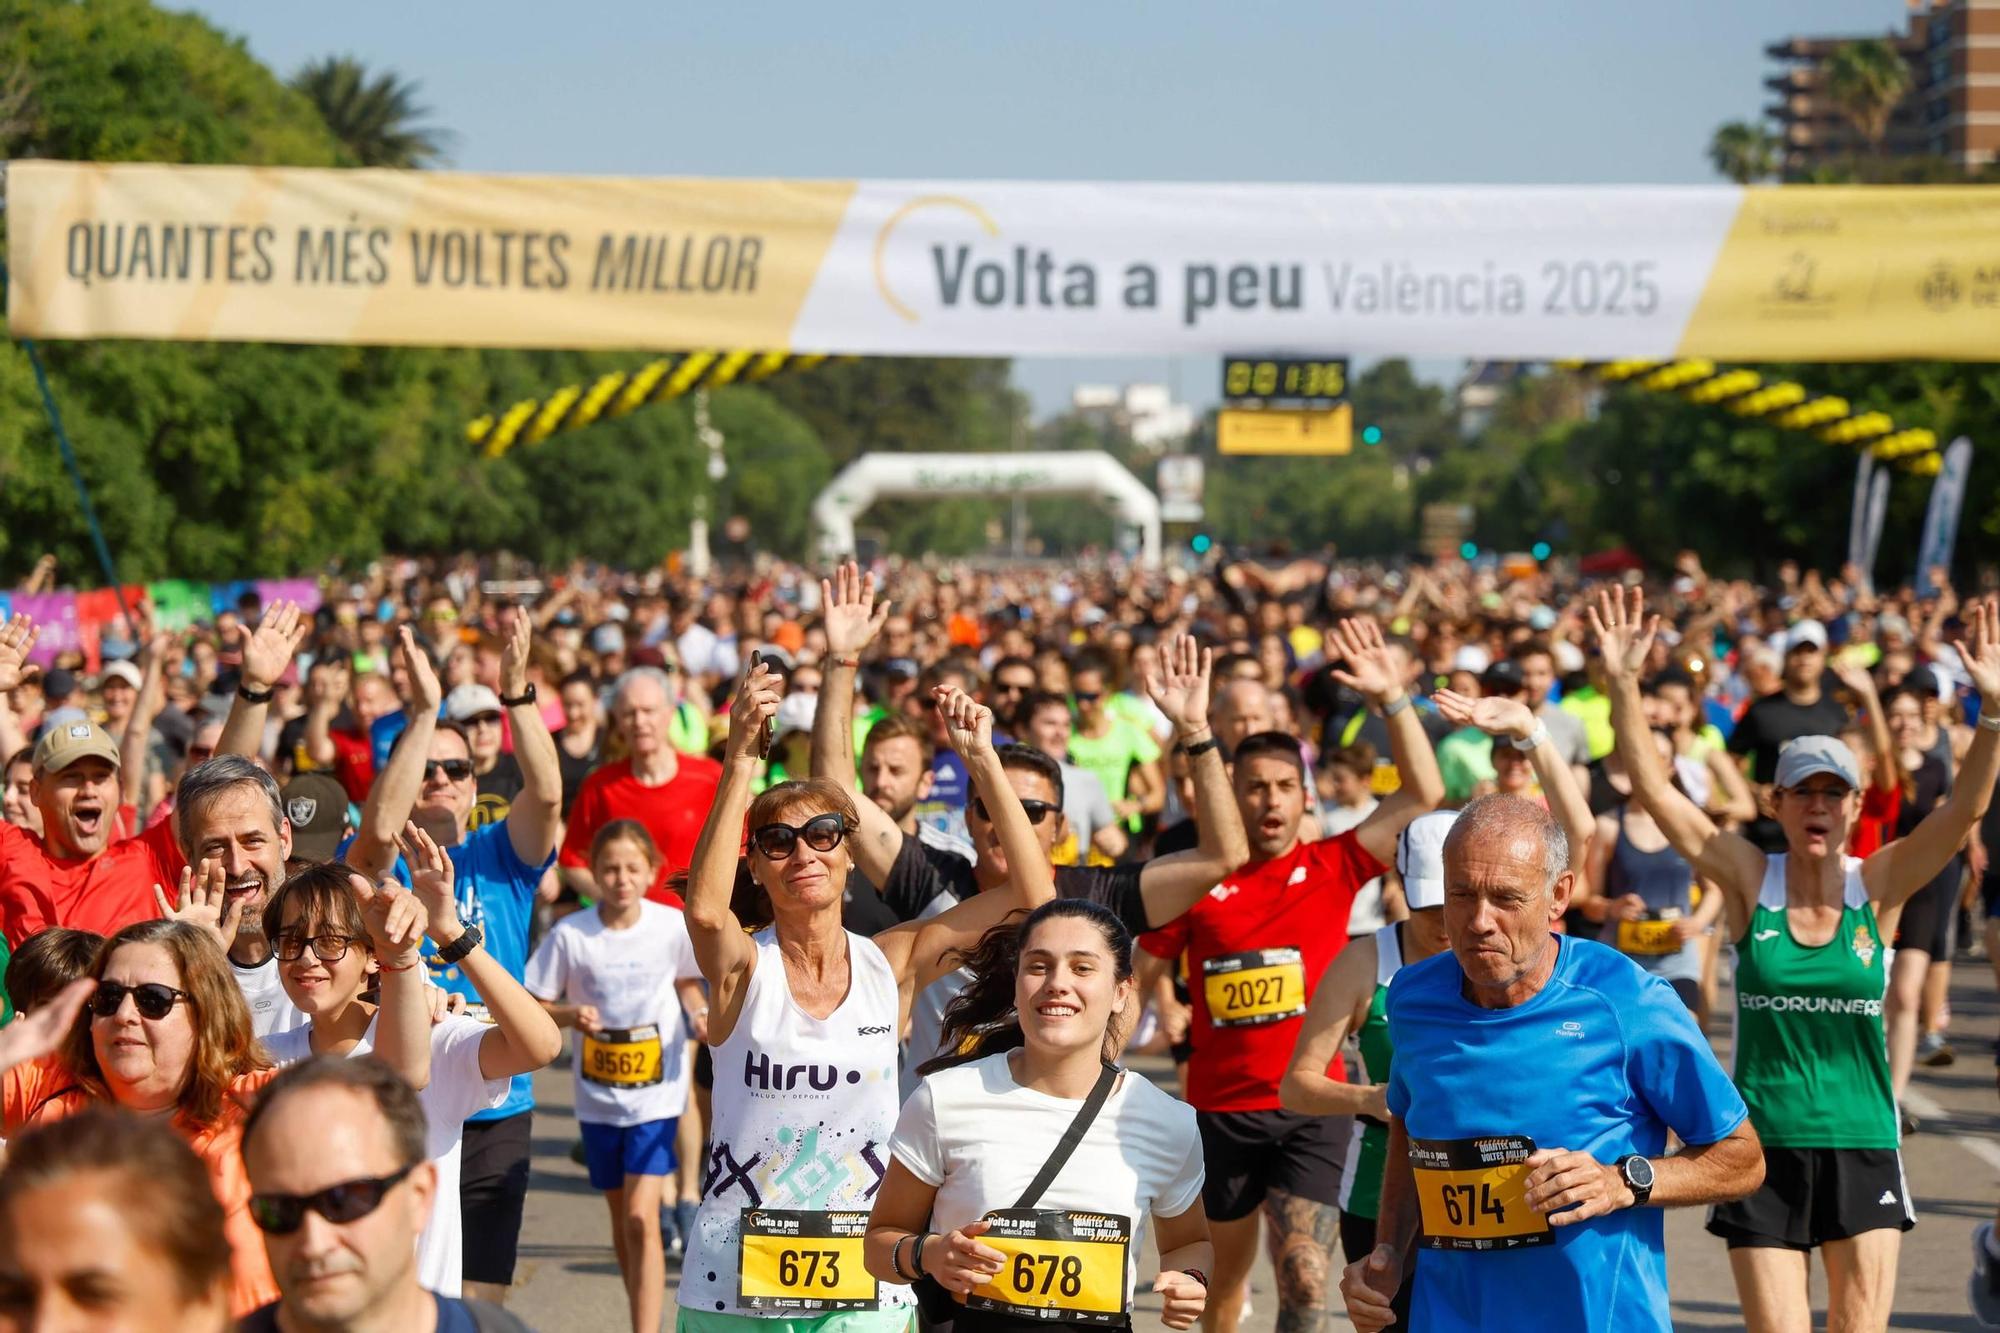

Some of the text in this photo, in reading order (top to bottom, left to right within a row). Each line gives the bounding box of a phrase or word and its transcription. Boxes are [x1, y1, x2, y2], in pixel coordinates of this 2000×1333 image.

[66, 211, 764, 294] QUANTES MÉS VOLTES MILLOR
[930, 244, 1661, 327] Volta a peu València 2025
[1223, 976, 1284, 1011] 2027
[594, 1049, 646, 1076] 9562
[750, 1091, 776, 1099] SALUD
[1481, 1151, 1505, 1162] VOLTES
[1442, 1183, 1505, 1226] 674
[756, 1217, 776, 1227] Volta
[784, 1220, 799, 1229] peu
[988, 1217, 1036, 1230] Volta a peu
[1023, 1229, 1036, 1237] 2025
[1073, 1227, 1096, 1237] VOLTES
[780, 1249, 841, 1289] 673
[1012, 1252, 1083, 1298] 678
